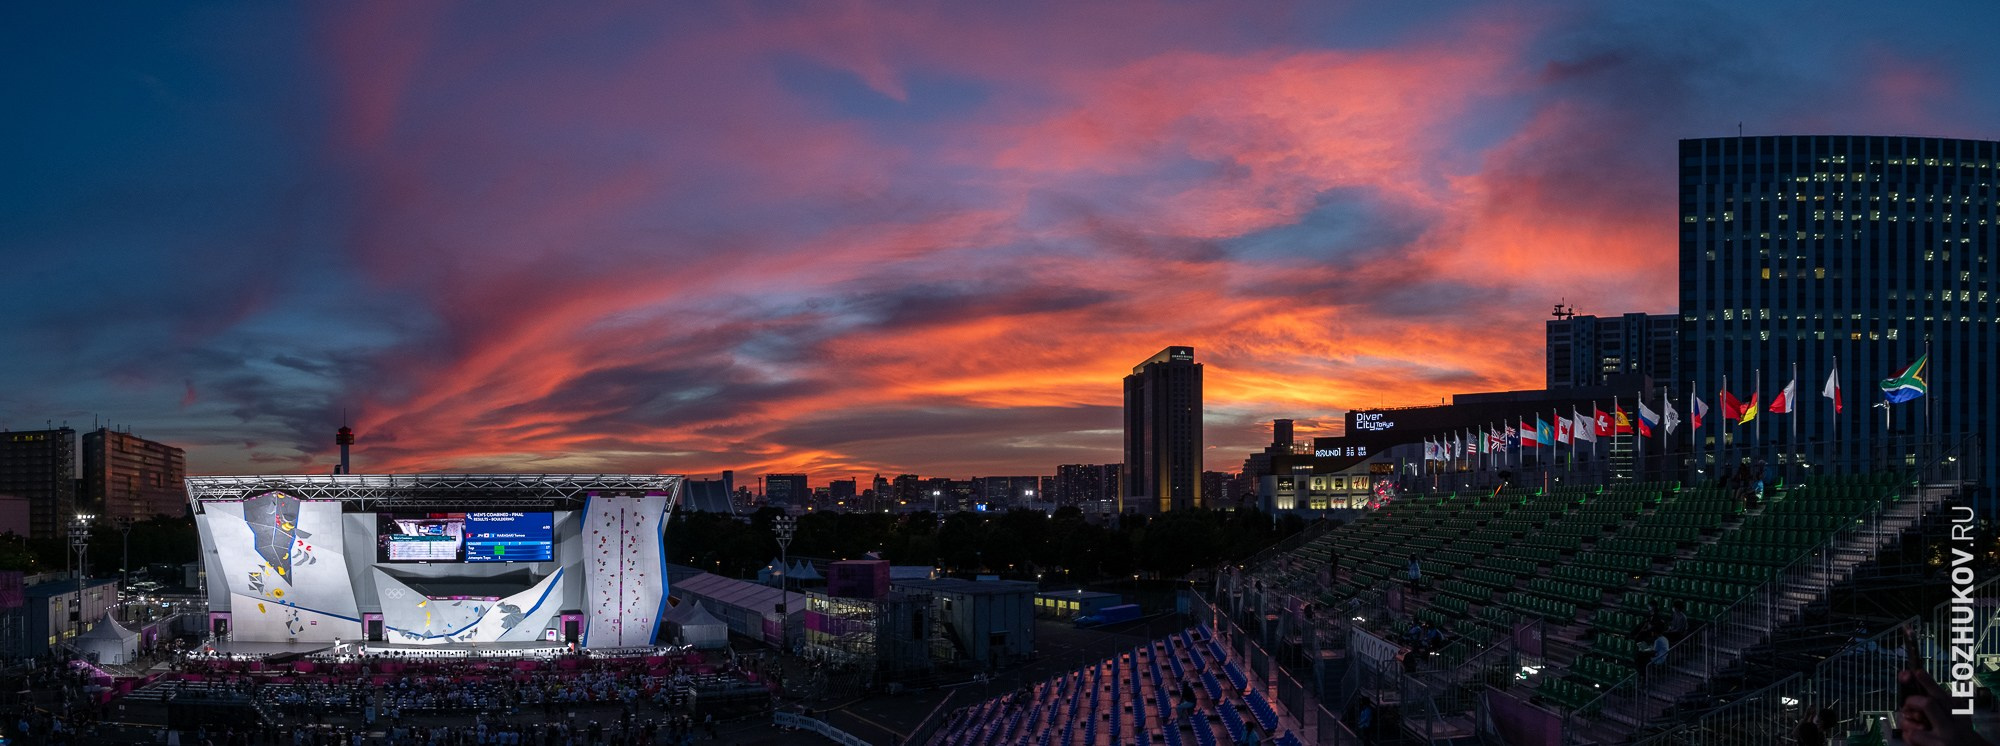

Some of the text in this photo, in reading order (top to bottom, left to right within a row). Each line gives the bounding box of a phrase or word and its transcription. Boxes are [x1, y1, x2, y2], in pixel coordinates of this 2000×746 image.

[1356, 413, 1383, 421] Diver
[1356, 421, 1375, 431] City
[1316, 448, 1341, 457] ROUND1
